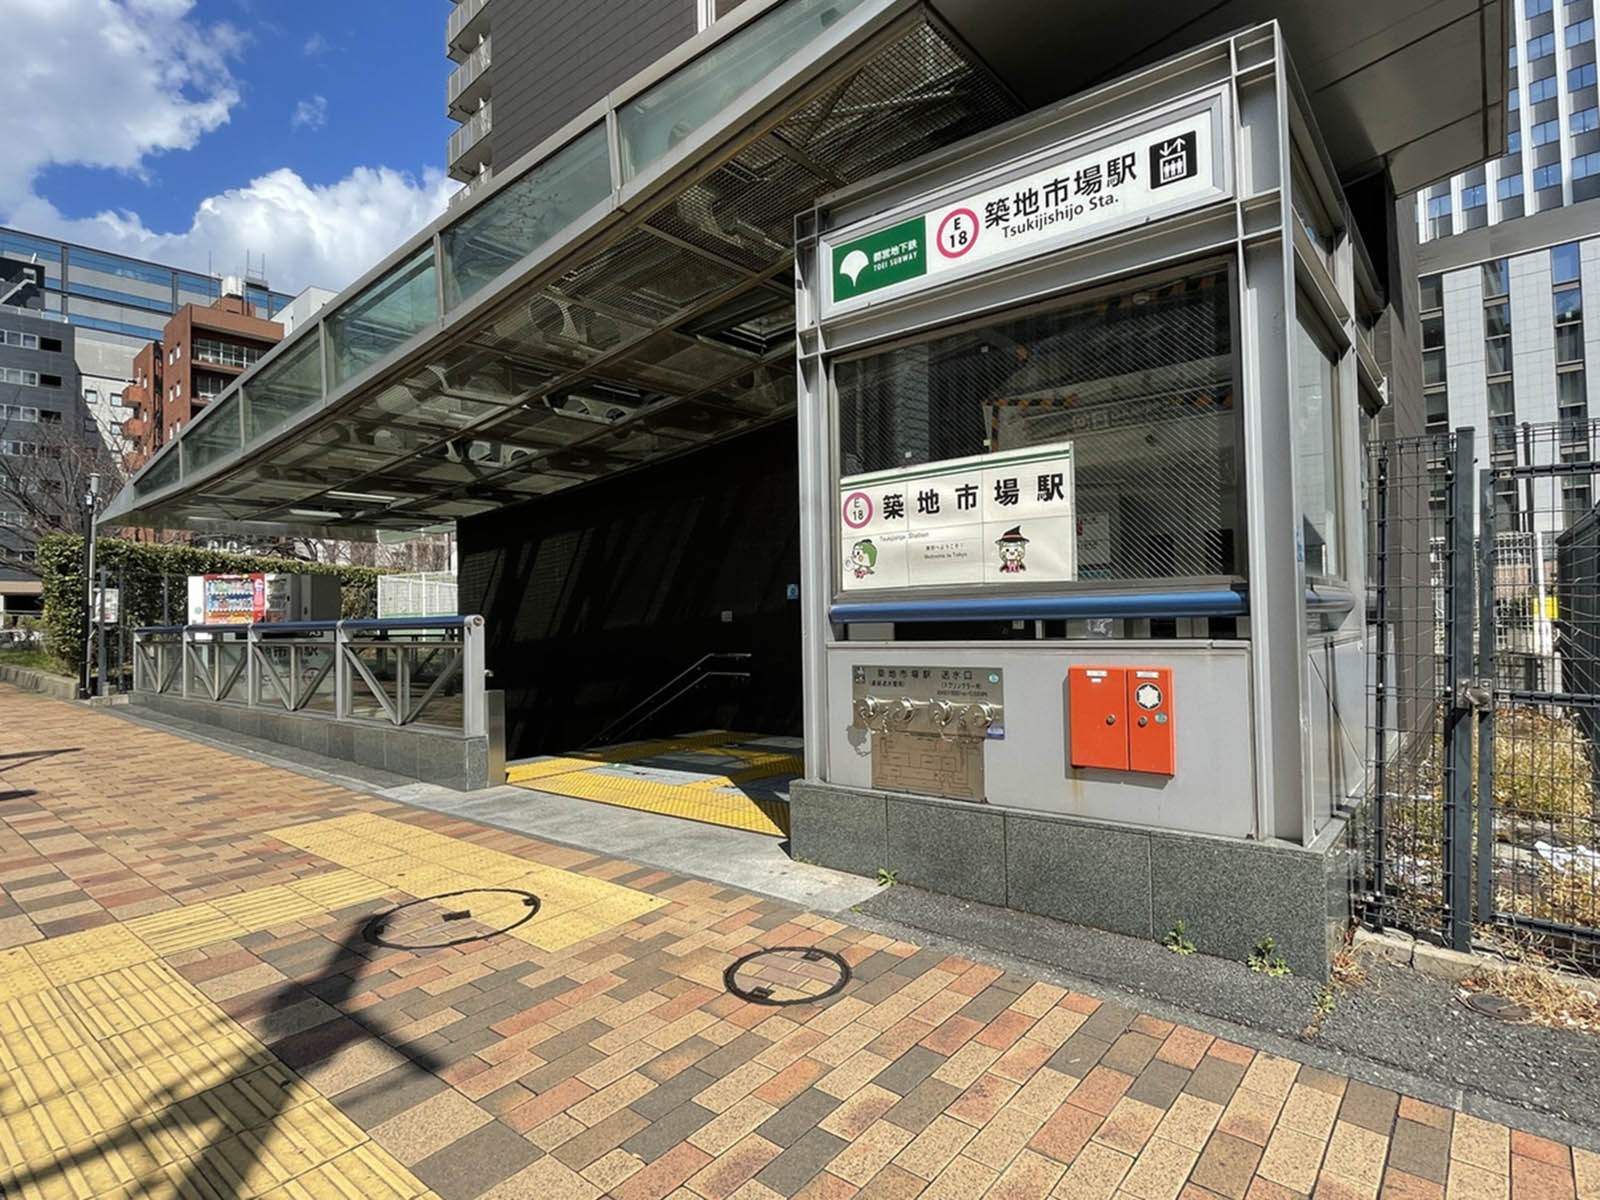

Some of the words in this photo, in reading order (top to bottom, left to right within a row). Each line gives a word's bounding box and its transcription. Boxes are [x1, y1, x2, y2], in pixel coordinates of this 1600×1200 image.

[985, 152, 1136, 229] 築地市場駅
[953, 217, 962, 231] E
[1002, 202, 1084, 239] Tsukijishijo
[1089, 192, 1119, 211] Sta.
[949, 231, 968, 249] 18
[873, 261, 888, 272] TOEI
[889, 250, 918, 267] SUBWAY
[853, 498, 861, 509] E
[882, 473, 1065, 520] 築地市場駅
[852, 510, 865, 521] 18
